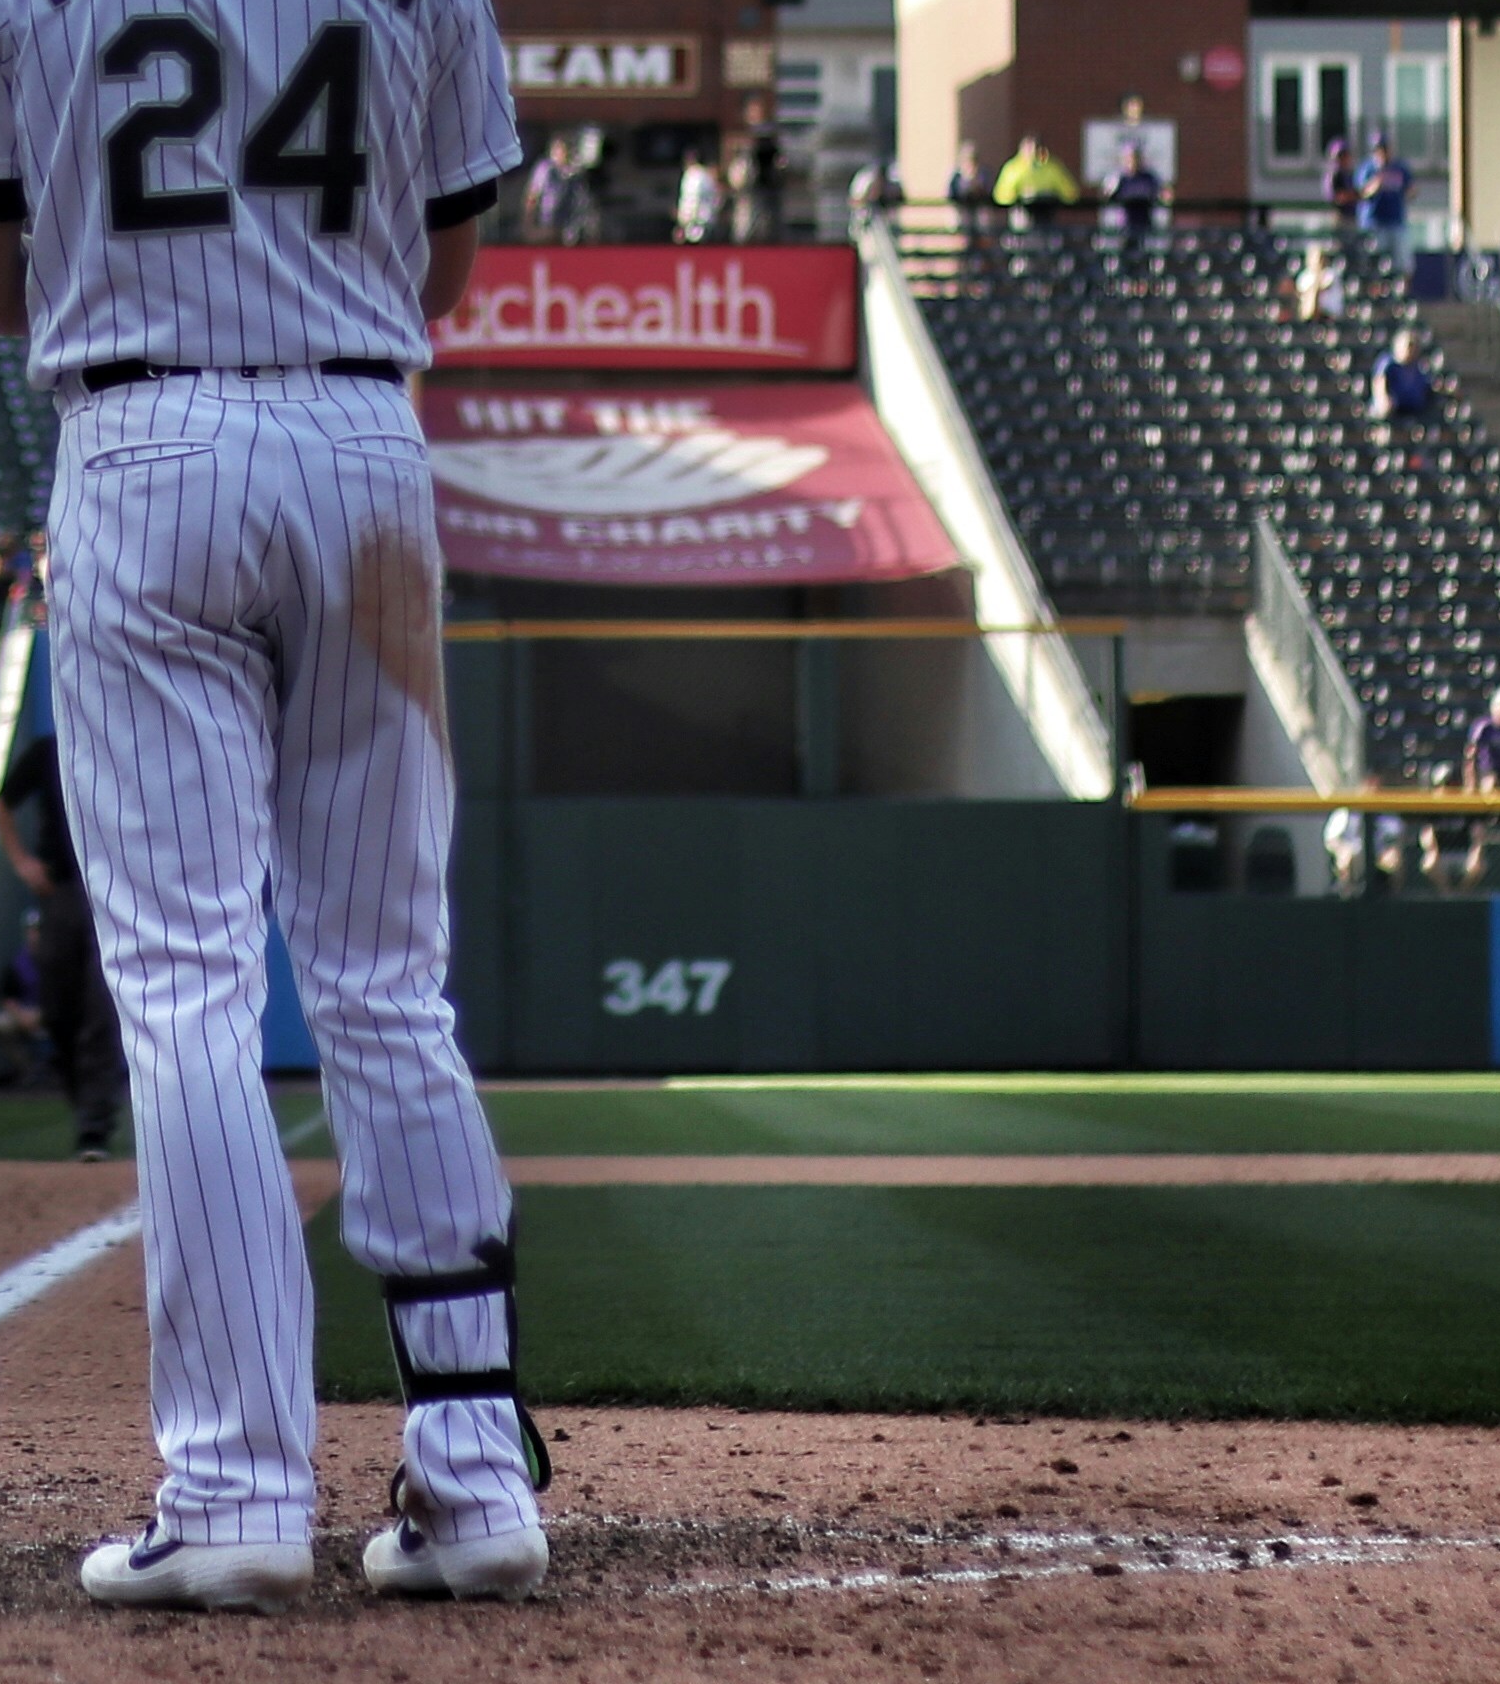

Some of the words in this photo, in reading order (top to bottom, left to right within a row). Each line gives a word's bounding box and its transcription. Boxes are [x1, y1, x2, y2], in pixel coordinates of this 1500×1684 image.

[502, 43, 674, 89] EAM
[101, 14, 373, 236] 24
[436, 260, 778, 350] uchealth
[602, 959, 733, 1015] 347
